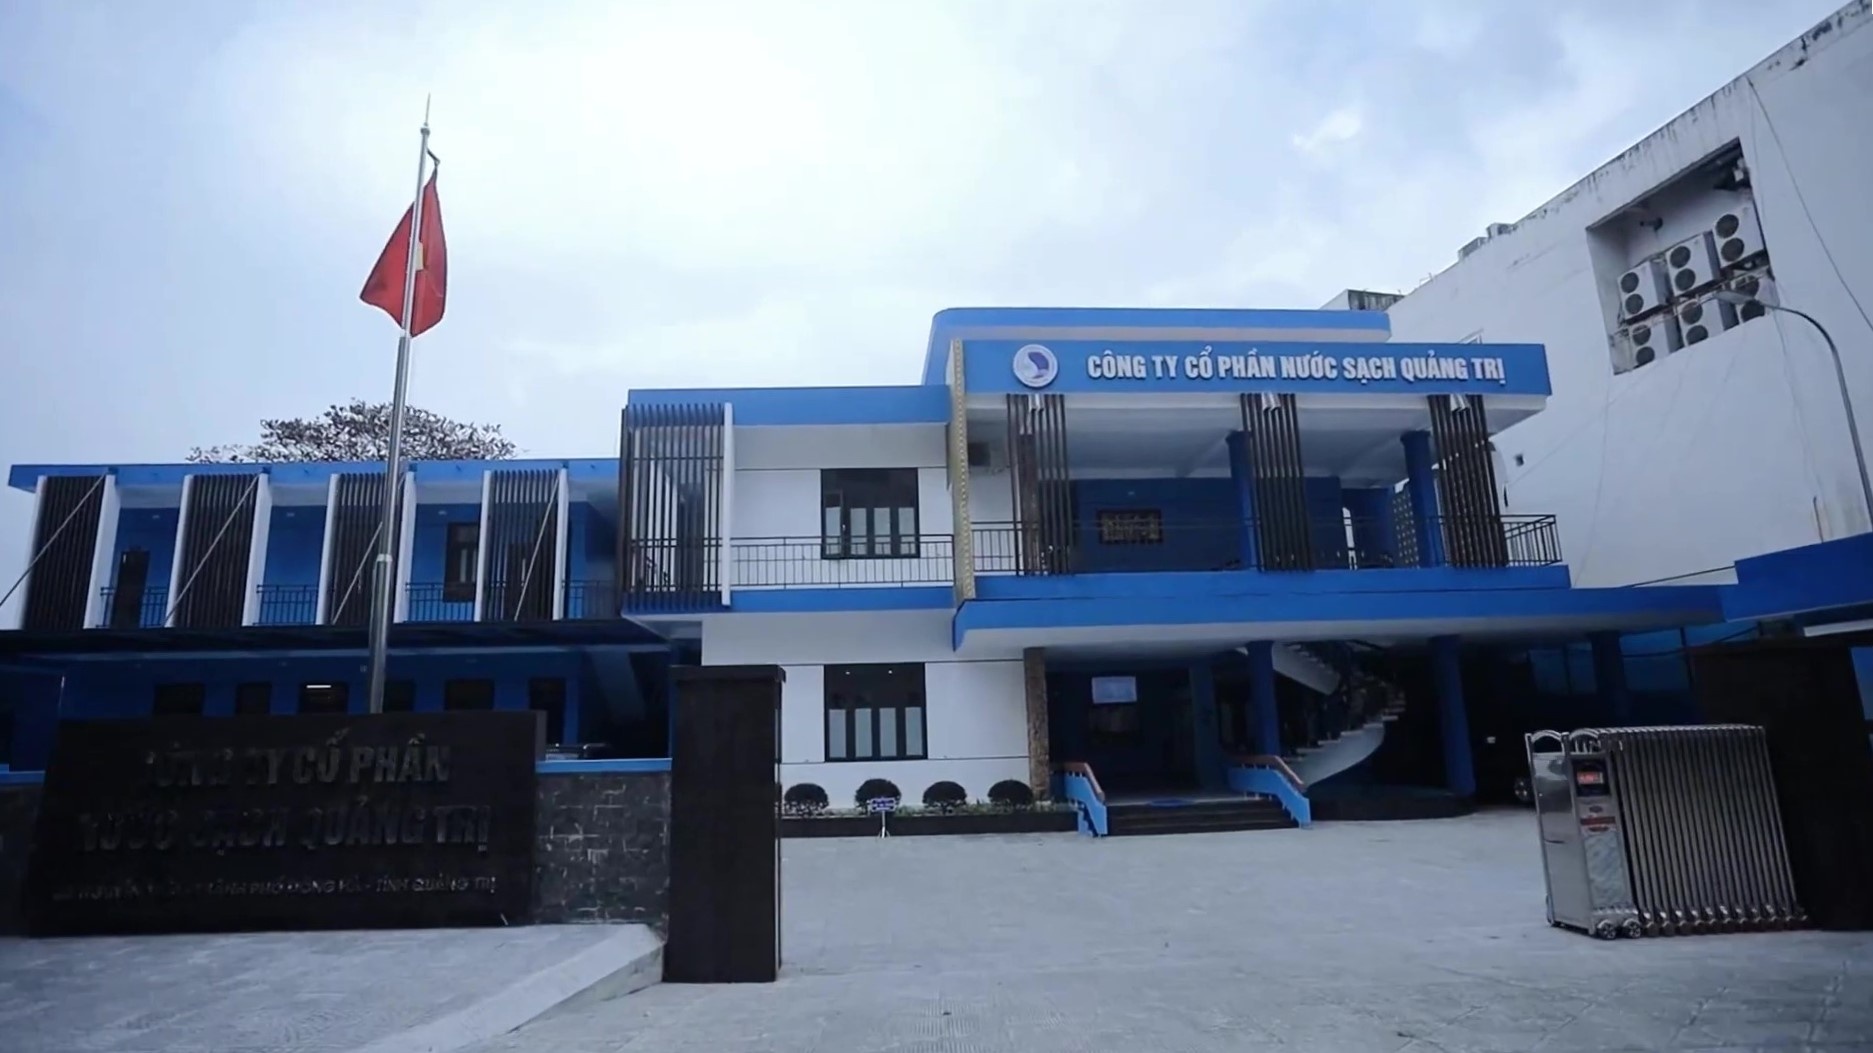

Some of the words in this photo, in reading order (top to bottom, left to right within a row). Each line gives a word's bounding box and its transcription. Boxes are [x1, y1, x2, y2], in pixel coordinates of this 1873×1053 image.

[1087, 350, 1147, 379] CÔNG
[1152, 355, 1179, 379] TY
[1184, 345, 1214, 379] CỔ
[1217, 348, 1277, 379] PHẦN
[1281, 350, 1338, 380] NƯỚC
[1342, 356, 1397, 384] SẠCH
[1400, 350, 1468, 383] QUẢNG
[1470, 357, 1506, 384] TRỊ
